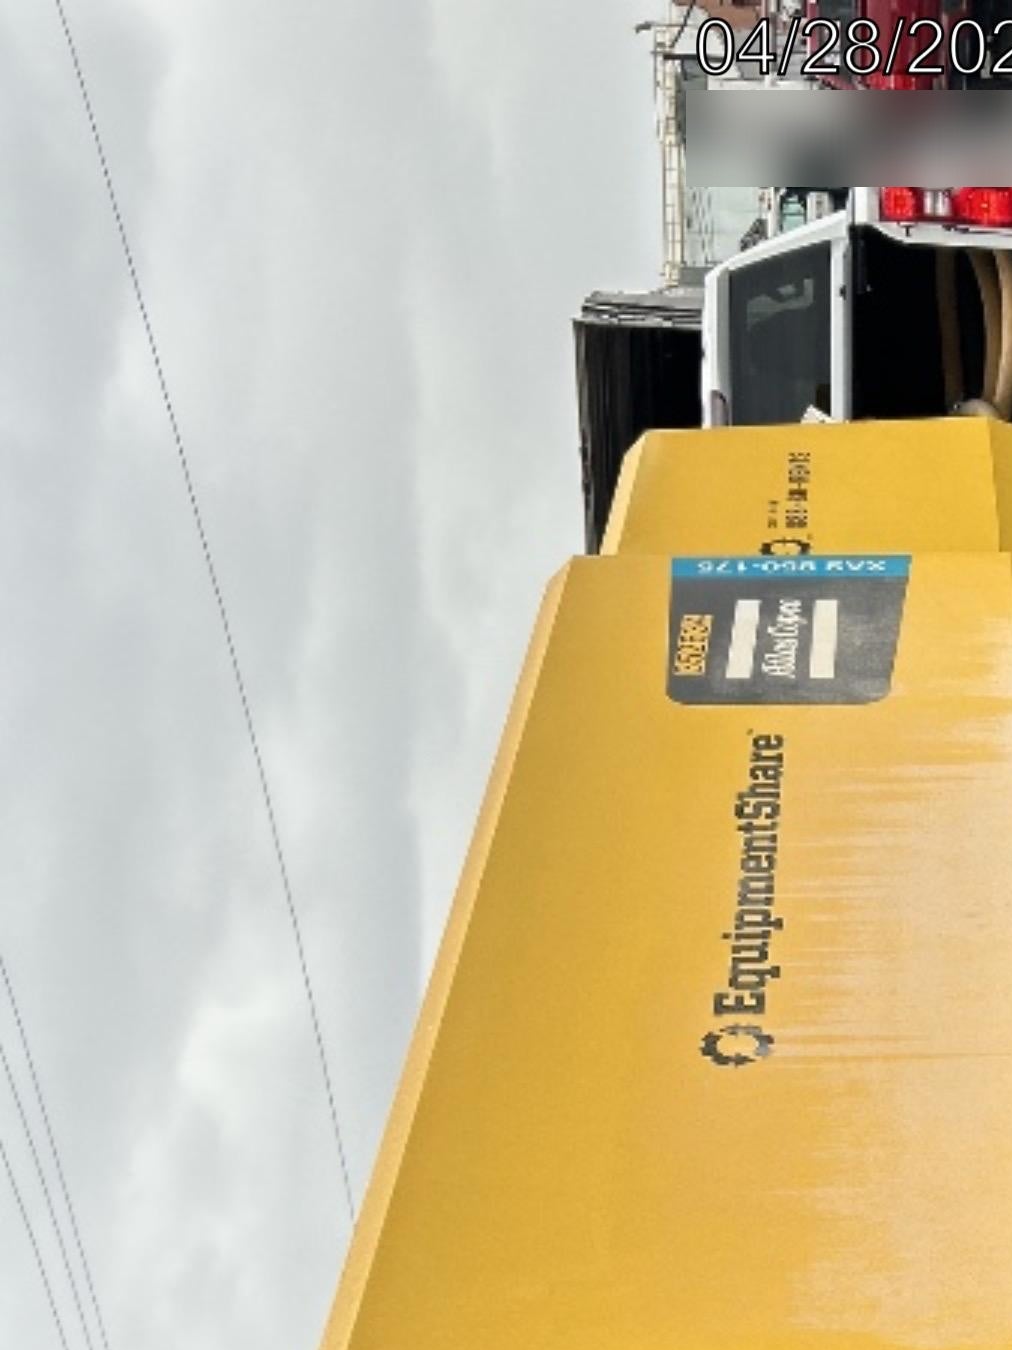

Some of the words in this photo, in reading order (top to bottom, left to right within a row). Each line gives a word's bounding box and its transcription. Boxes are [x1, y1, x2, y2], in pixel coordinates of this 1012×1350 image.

[766, 599, 808, 637] Copco
[761, 638, 797, 678] Atlas
[712, 733, 784, 1016] EquipmentShare
